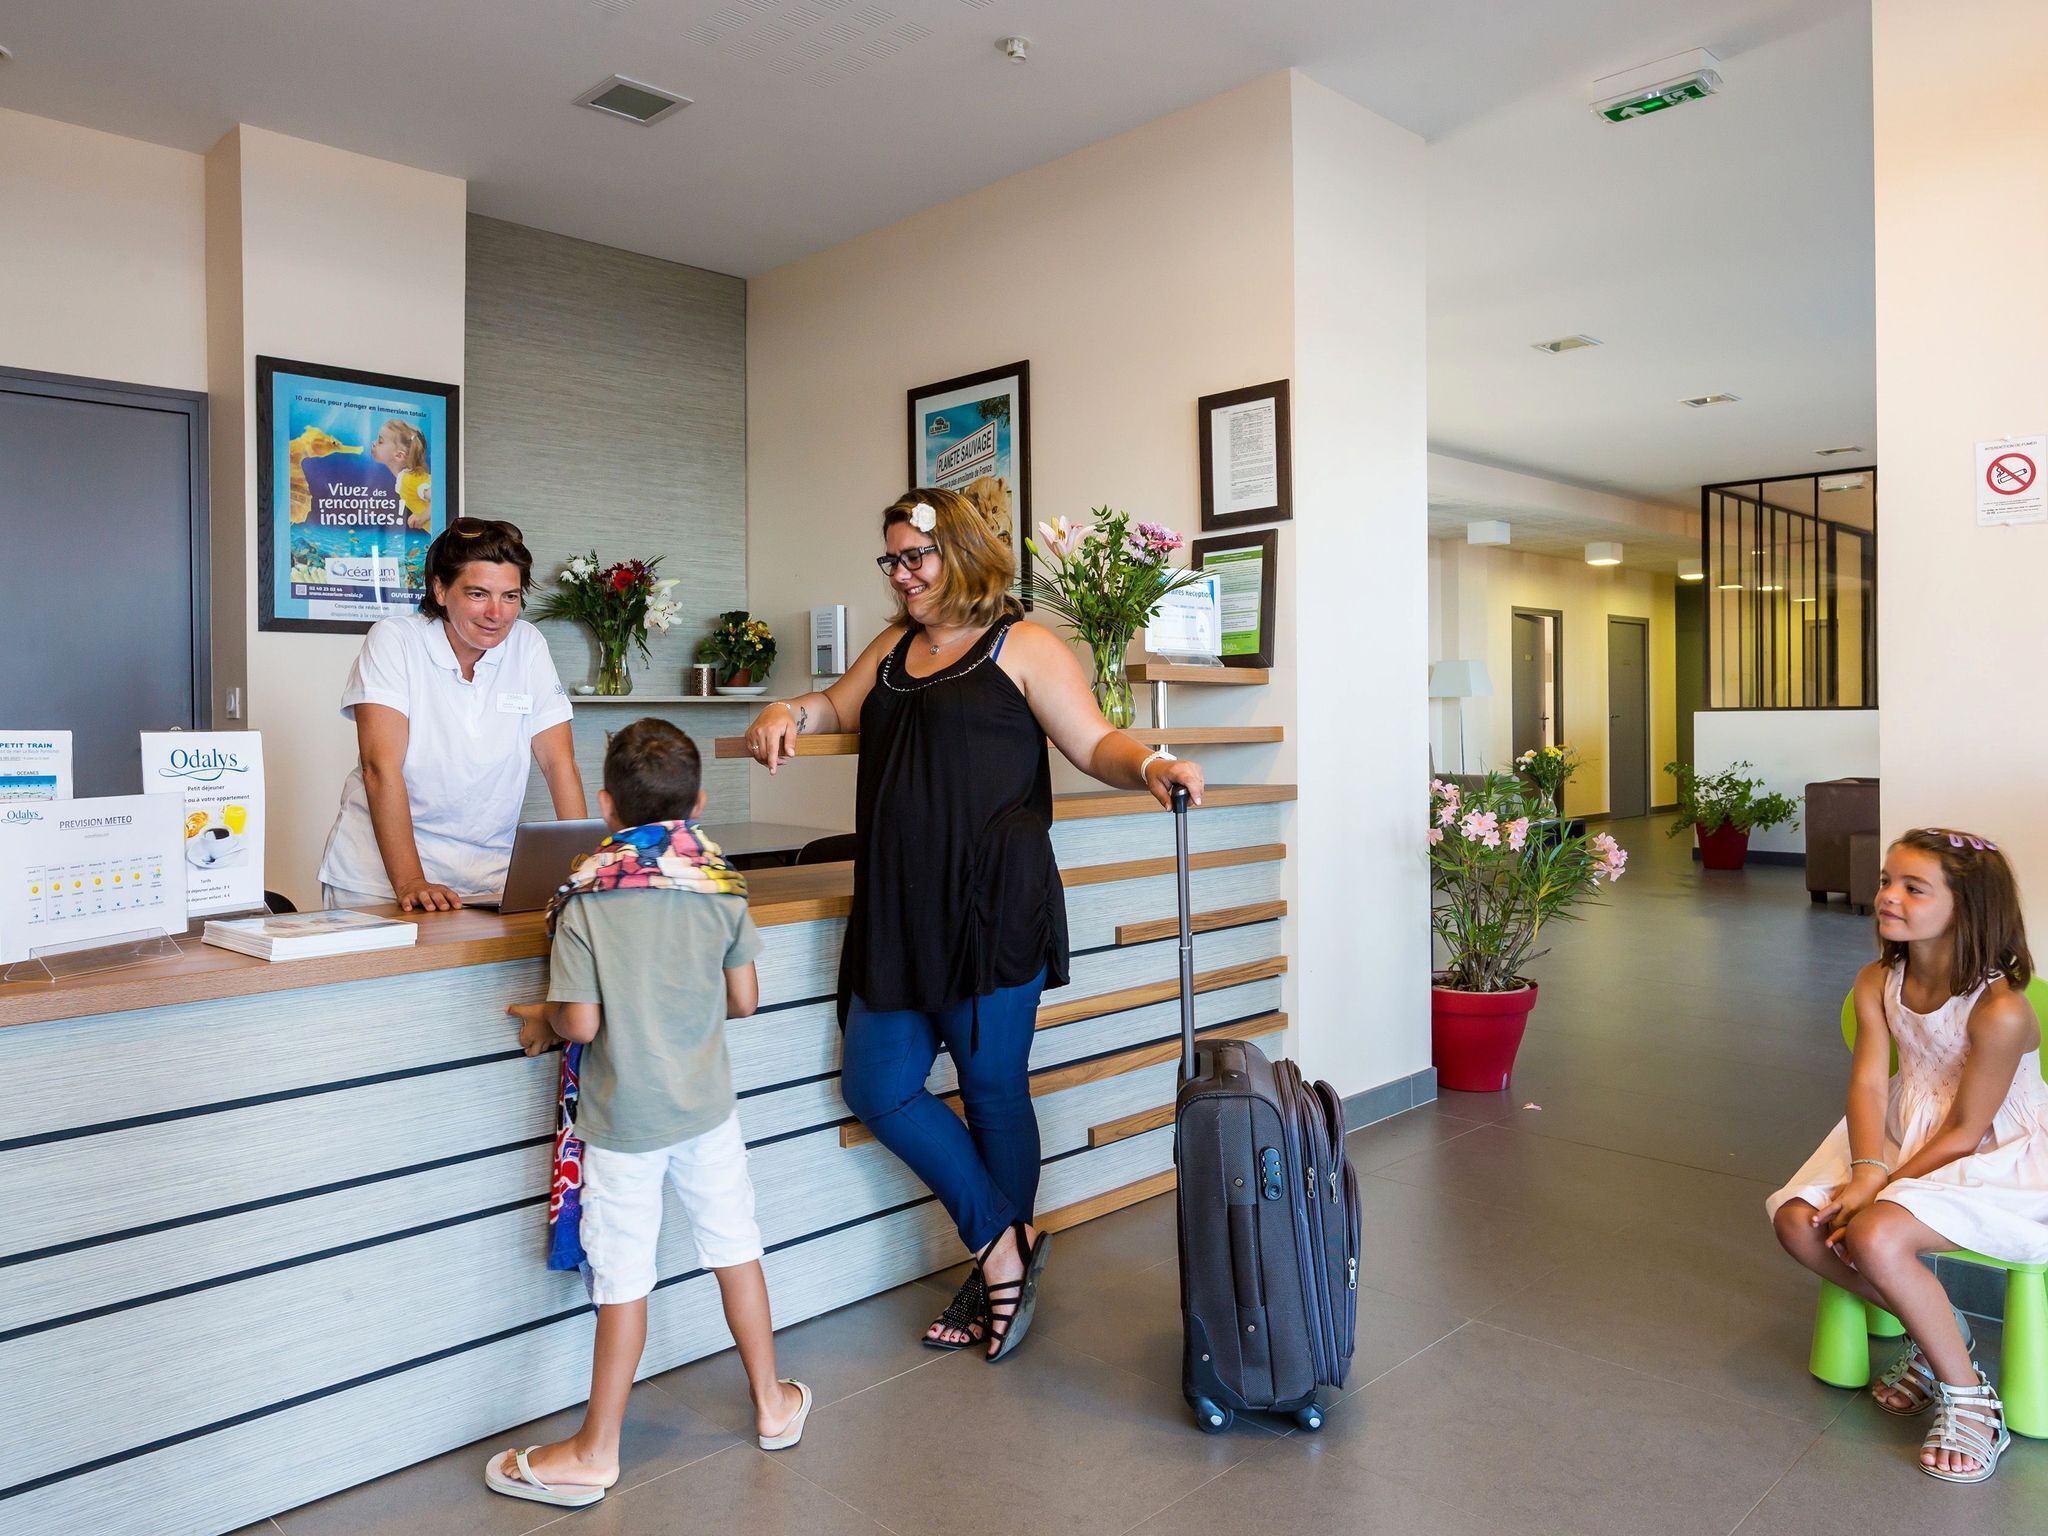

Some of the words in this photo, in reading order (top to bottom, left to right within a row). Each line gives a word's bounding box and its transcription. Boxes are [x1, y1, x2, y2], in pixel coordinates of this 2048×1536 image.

[304, 396, 327, 405] escales
[343, 401, 367, 411] plonger
[377, 405, 409, 416] immersion
[960, 430, 992, 462] SAUVAGE
[979, 464, 992, 475] France
[328, 482, 369, 497] Vivez
[372, 488, 387, 497] des
[318, 497, 396, 509] rencontres
[320, 500, 406, 526] insolites!
[390, 591, 414, 599] OUVERT
[168, 748, 241, 780] Odalys
[216, 794, 250, 802] appartement
[59, 818, 103, 829] PREVISION
[104, 815, 133, 825] METEO
